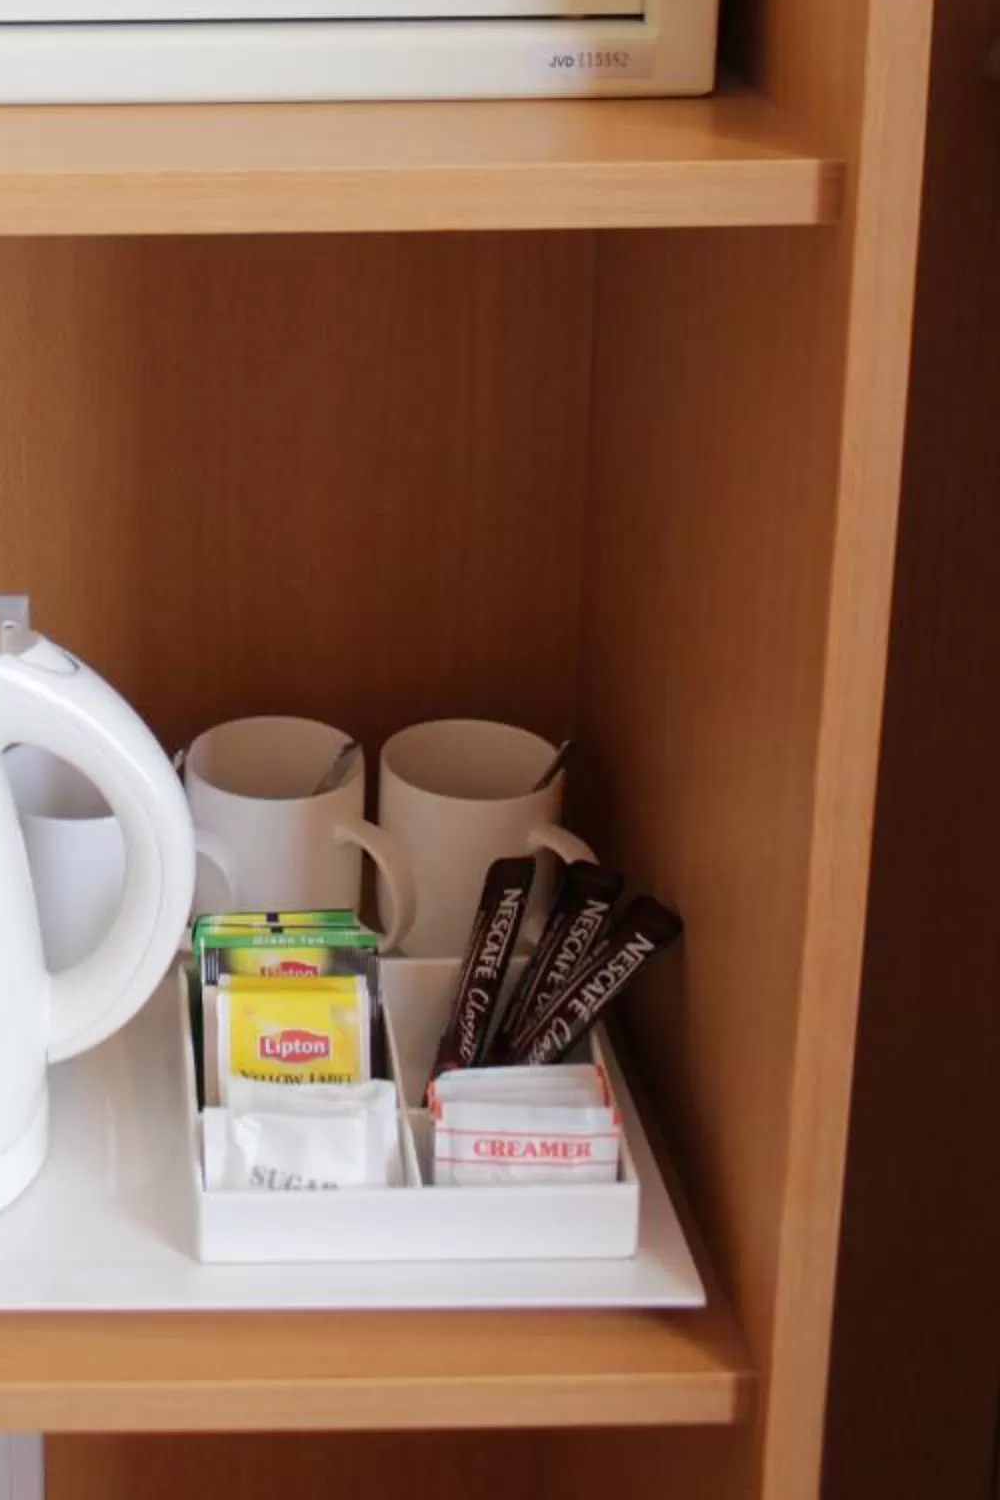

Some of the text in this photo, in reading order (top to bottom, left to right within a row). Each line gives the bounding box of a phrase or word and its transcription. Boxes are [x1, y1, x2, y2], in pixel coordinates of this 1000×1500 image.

[548, 55, 576, 69] JVD
[265, 1038, 326, 1058] Lipton
[473, 1139, 592, 1159] CREAMER
